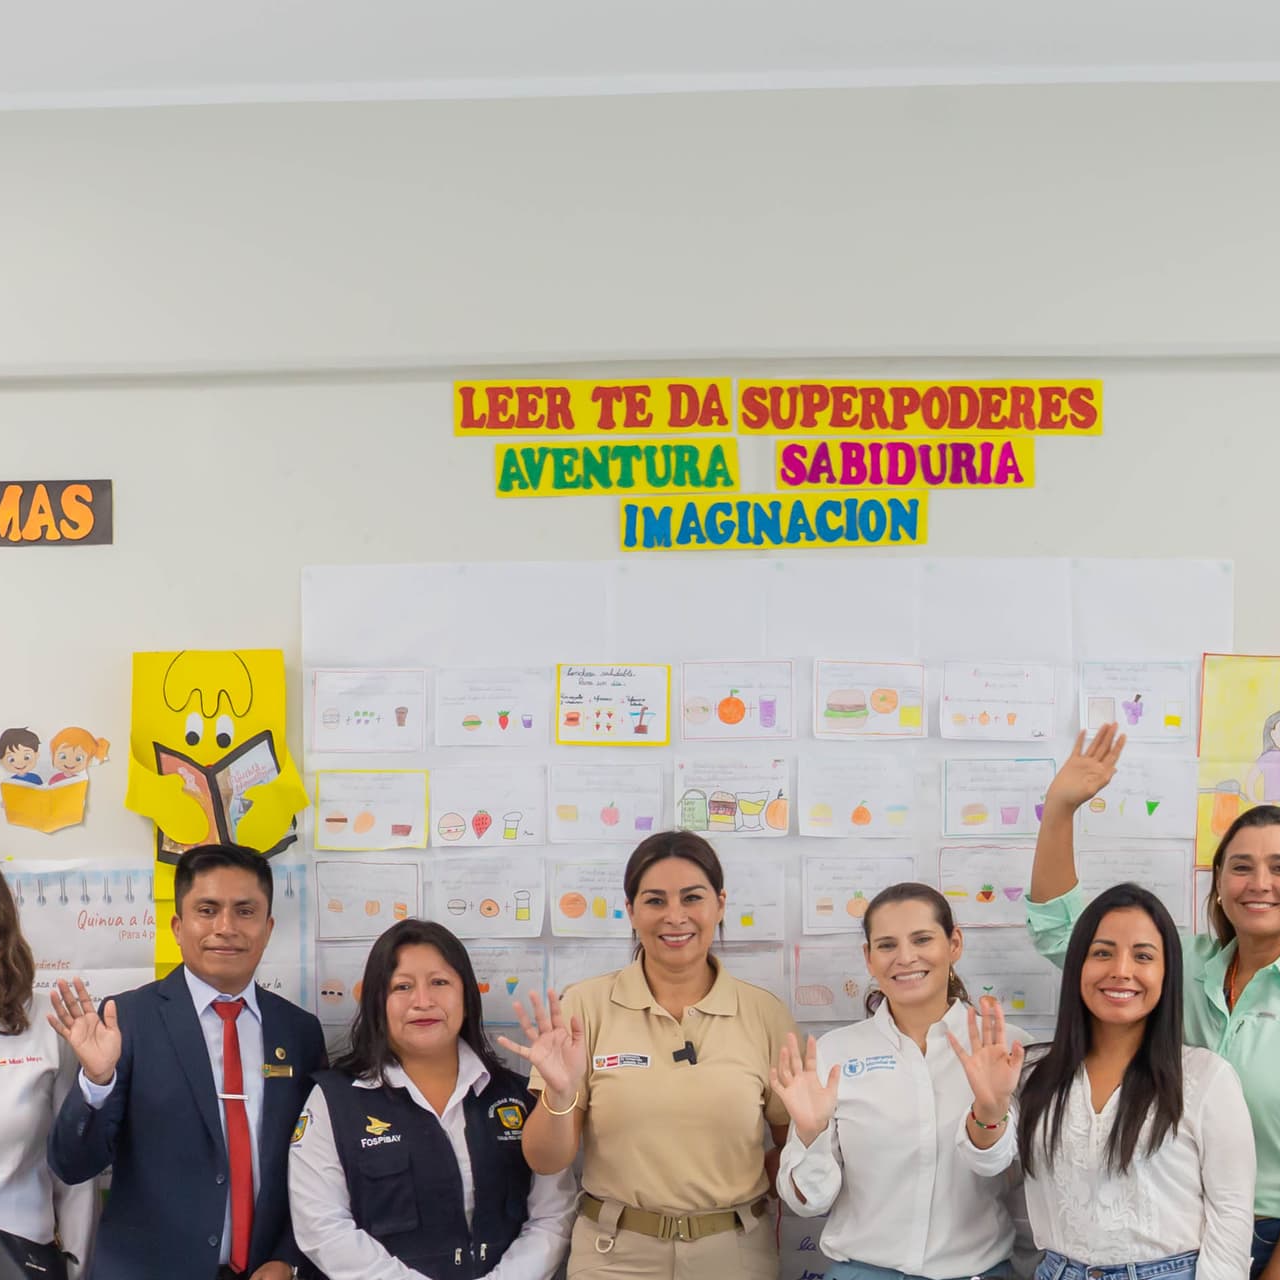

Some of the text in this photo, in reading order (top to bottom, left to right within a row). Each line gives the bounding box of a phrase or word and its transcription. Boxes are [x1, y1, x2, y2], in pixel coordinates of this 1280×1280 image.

[460, 384, 1097, 430] LEER TE DA SUPERPODERES
[498, 444, 734, 492] AVENTURA
[780, 441, 1024, 486] SABIDURIA
[624, 498, 919, 548] IMAGINACION
